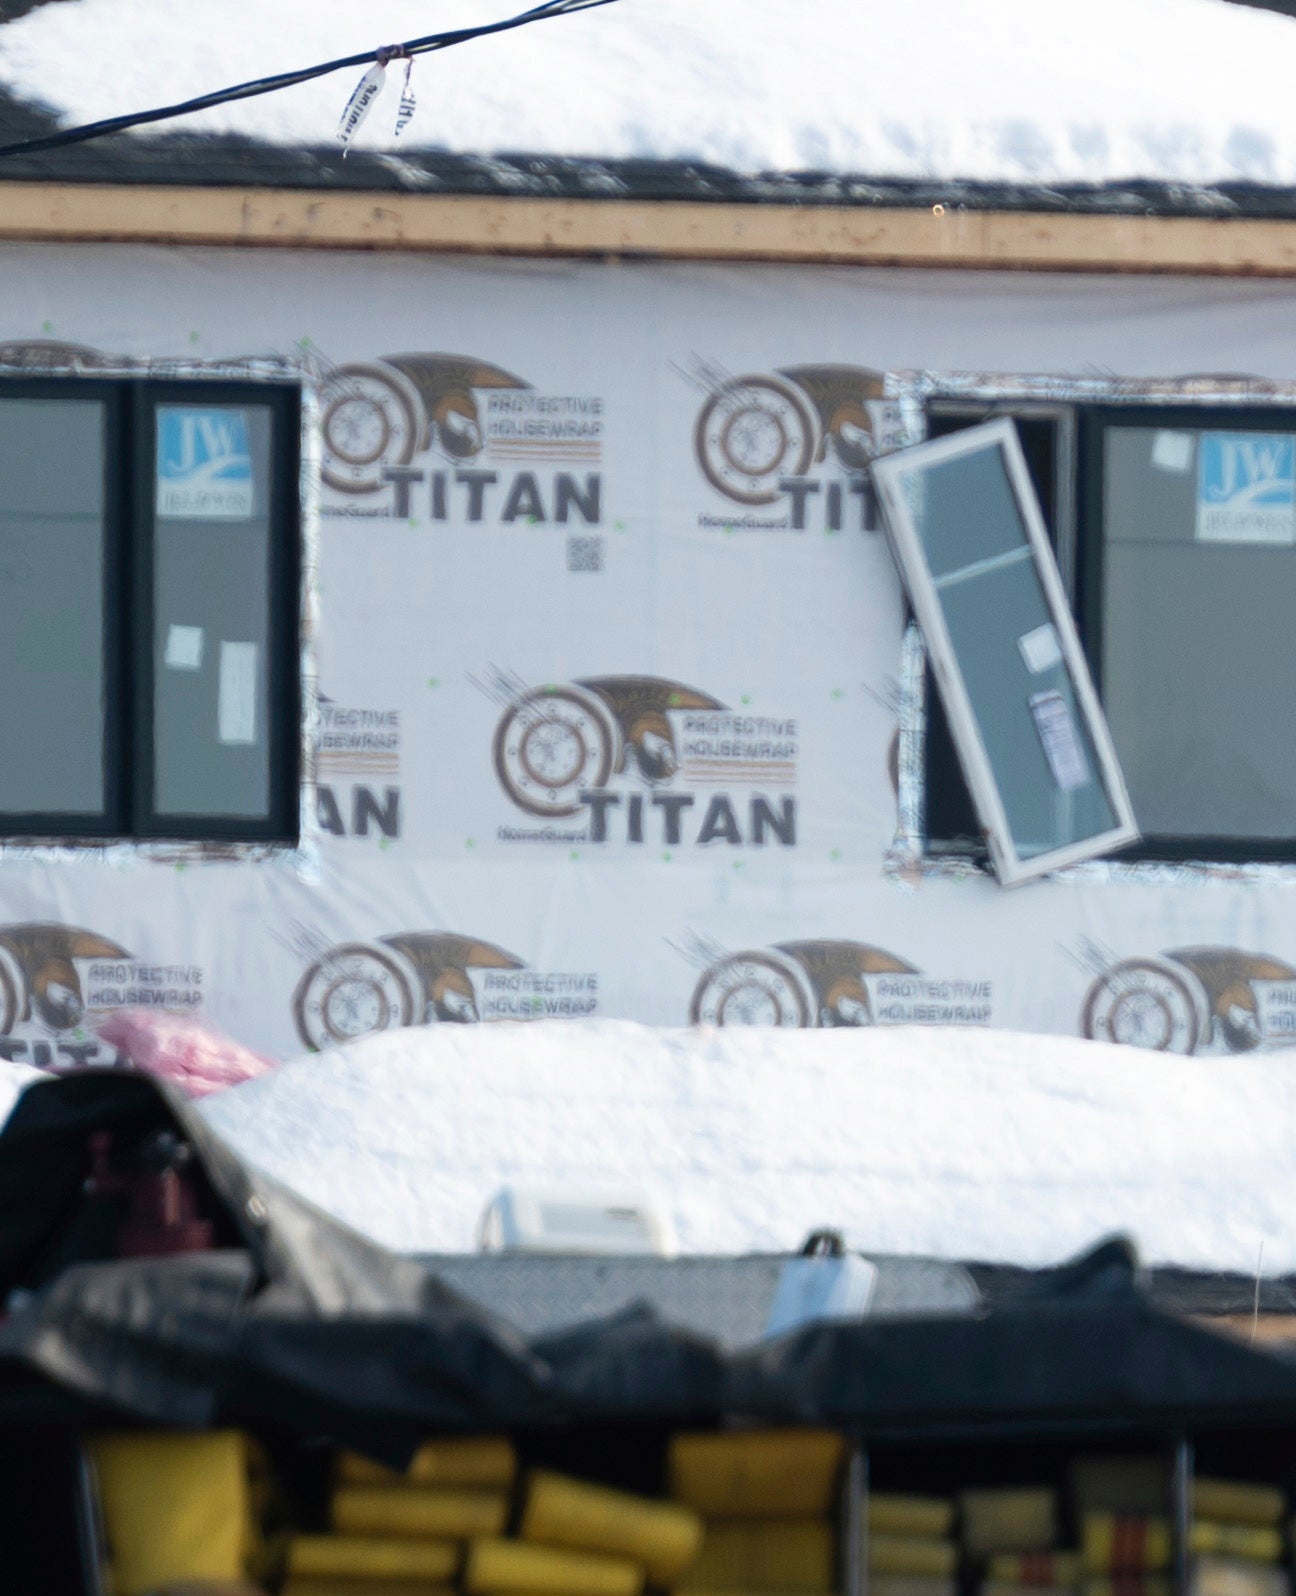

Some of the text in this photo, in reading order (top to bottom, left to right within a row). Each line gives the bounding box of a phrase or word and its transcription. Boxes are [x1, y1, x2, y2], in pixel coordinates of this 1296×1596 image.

[382, 470, 603, 524] TITAN
[781, 480, 877, 531] TIT
[578, 790, 797, 845] TITAN
